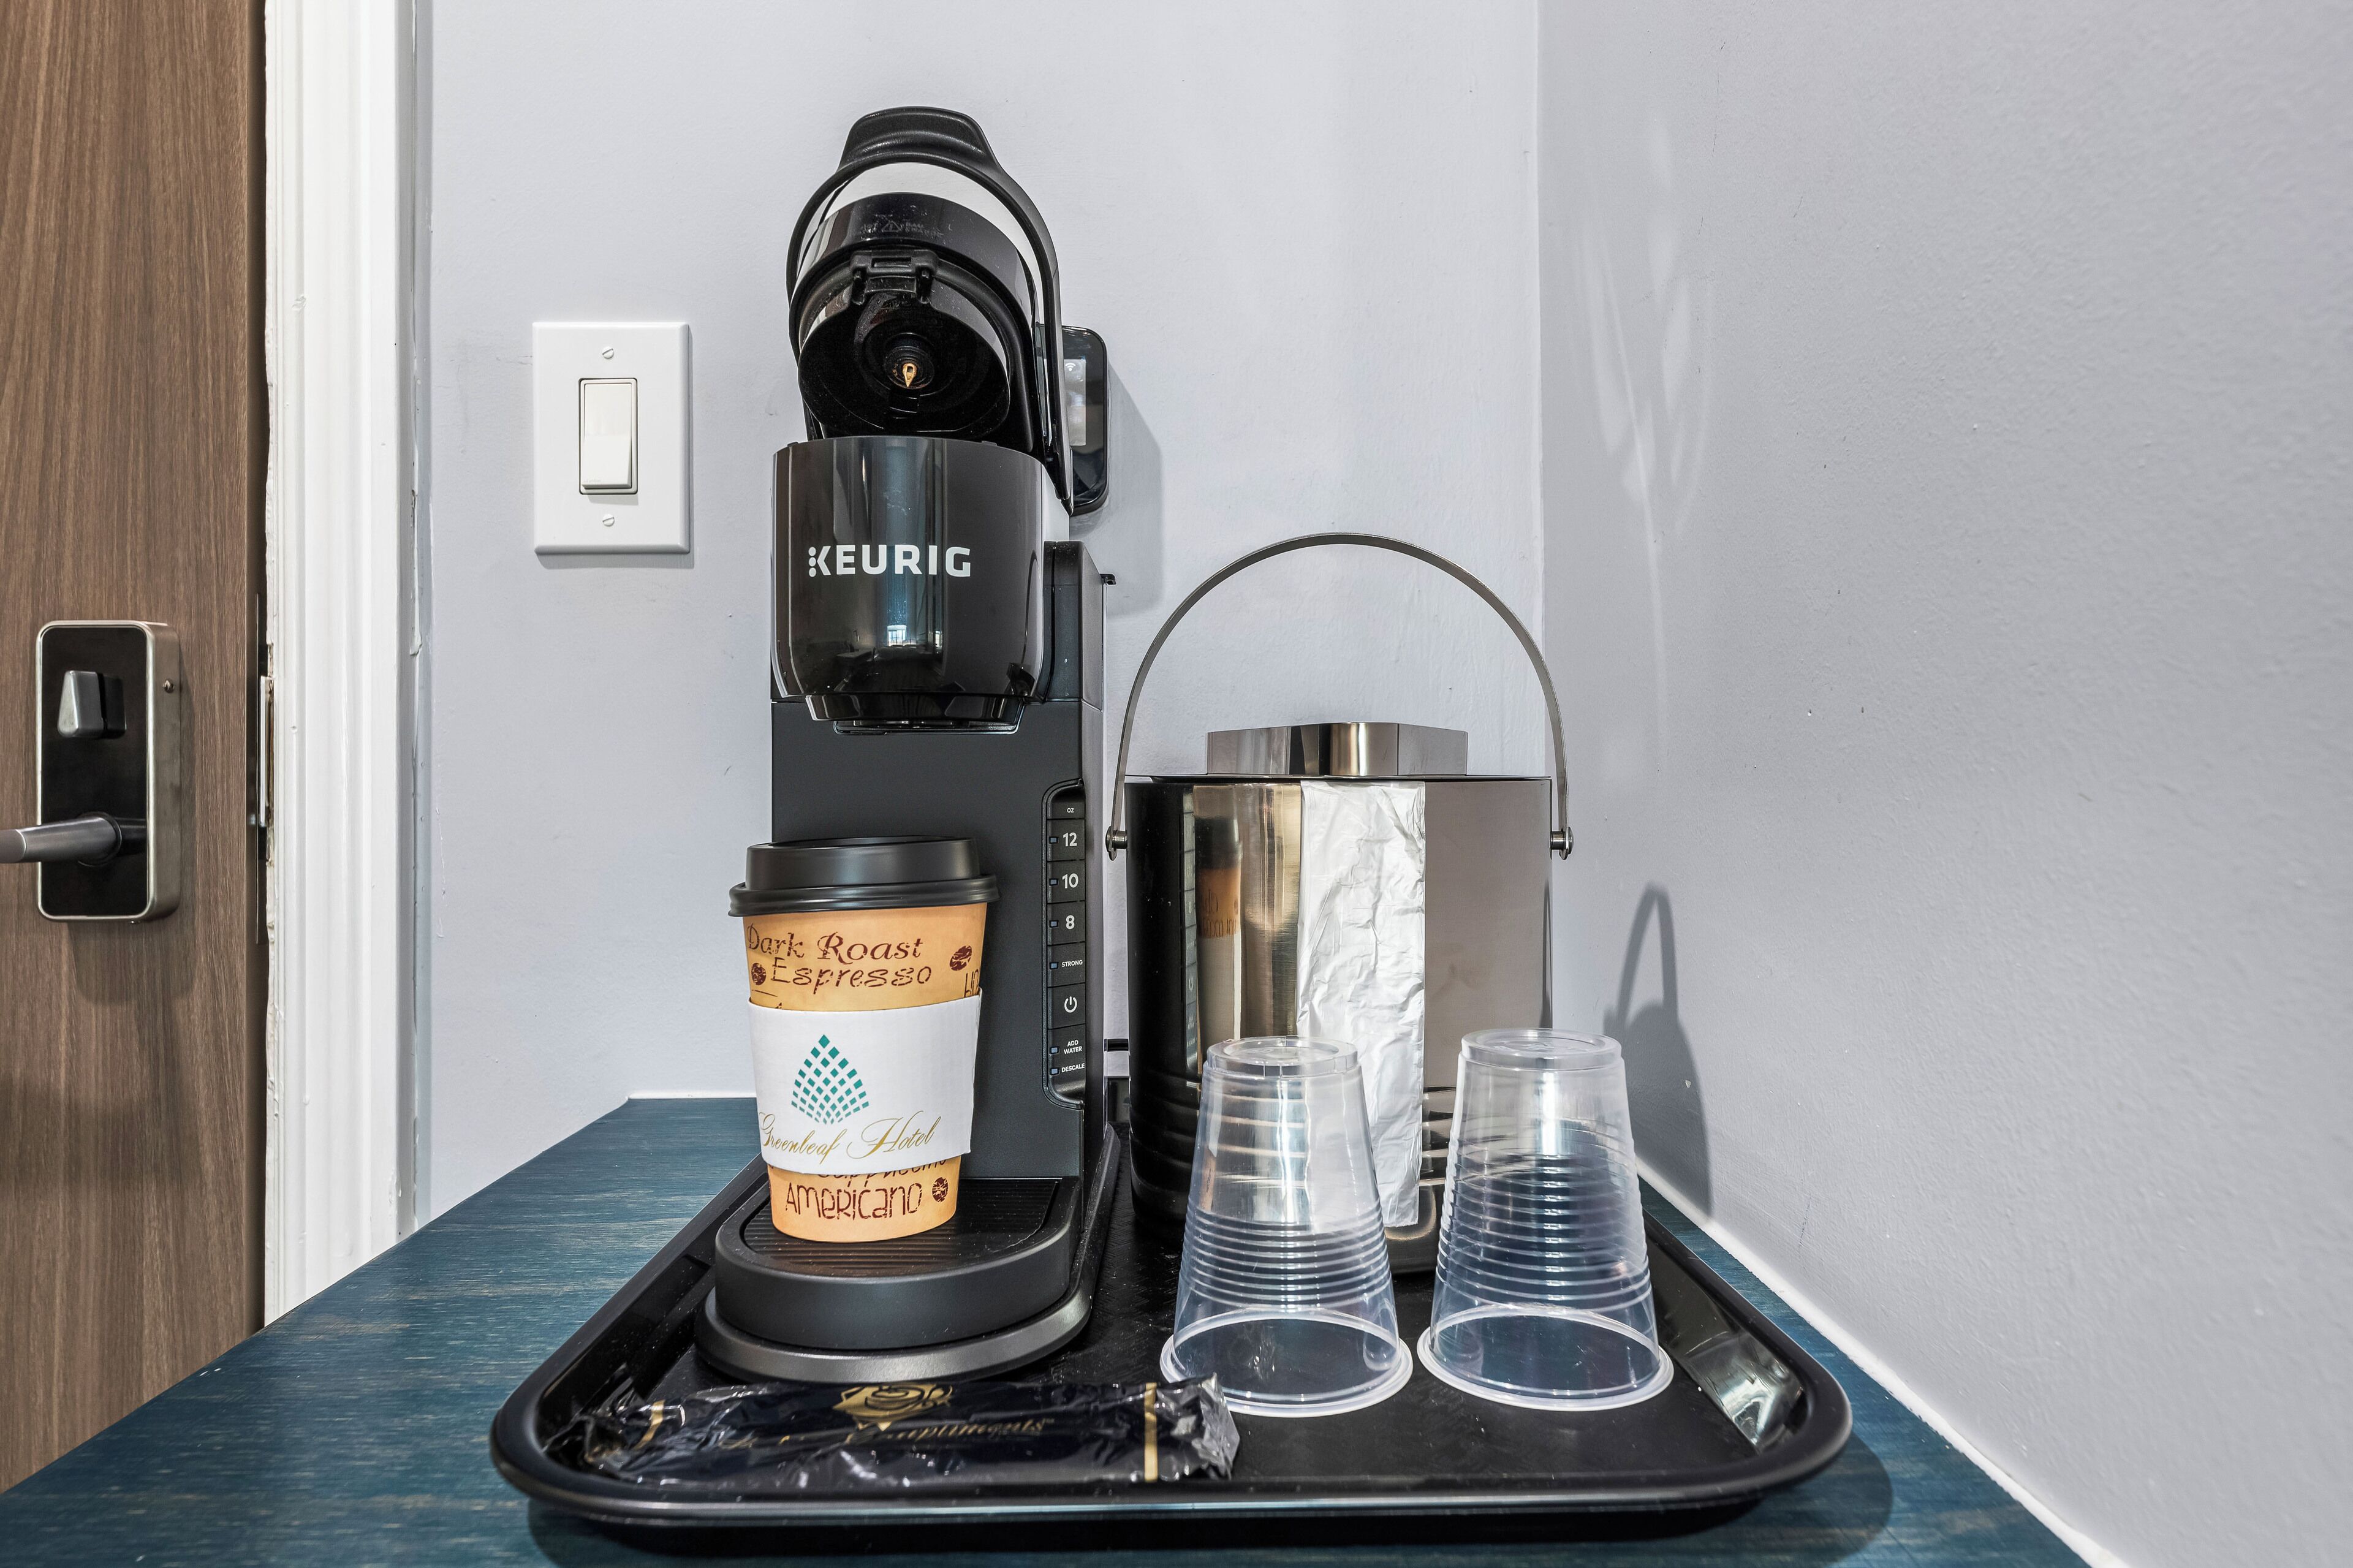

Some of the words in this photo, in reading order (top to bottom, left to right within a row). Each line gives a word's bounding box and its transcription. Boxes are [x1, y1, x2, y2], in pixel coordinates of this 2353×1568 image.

[808, 543, 971, 577] KEURIG
[1063, 832, 1077, 847] 12
[1062, 873, 1079, 888] 10
[1066, 915, 1075, 930] 8
[746, 922, 805, 958] Dark
[817, 931, 923, 965] Roast
[770, 956, 932, 994] Espresso
[1063, 1046, 1083, 1055] WATER
[1061, 1062, 1085, 1073] DESCALE
[758, 1112, 848, 1164] Greenleaf
[846, 1110, 942, 1160] Hotel
